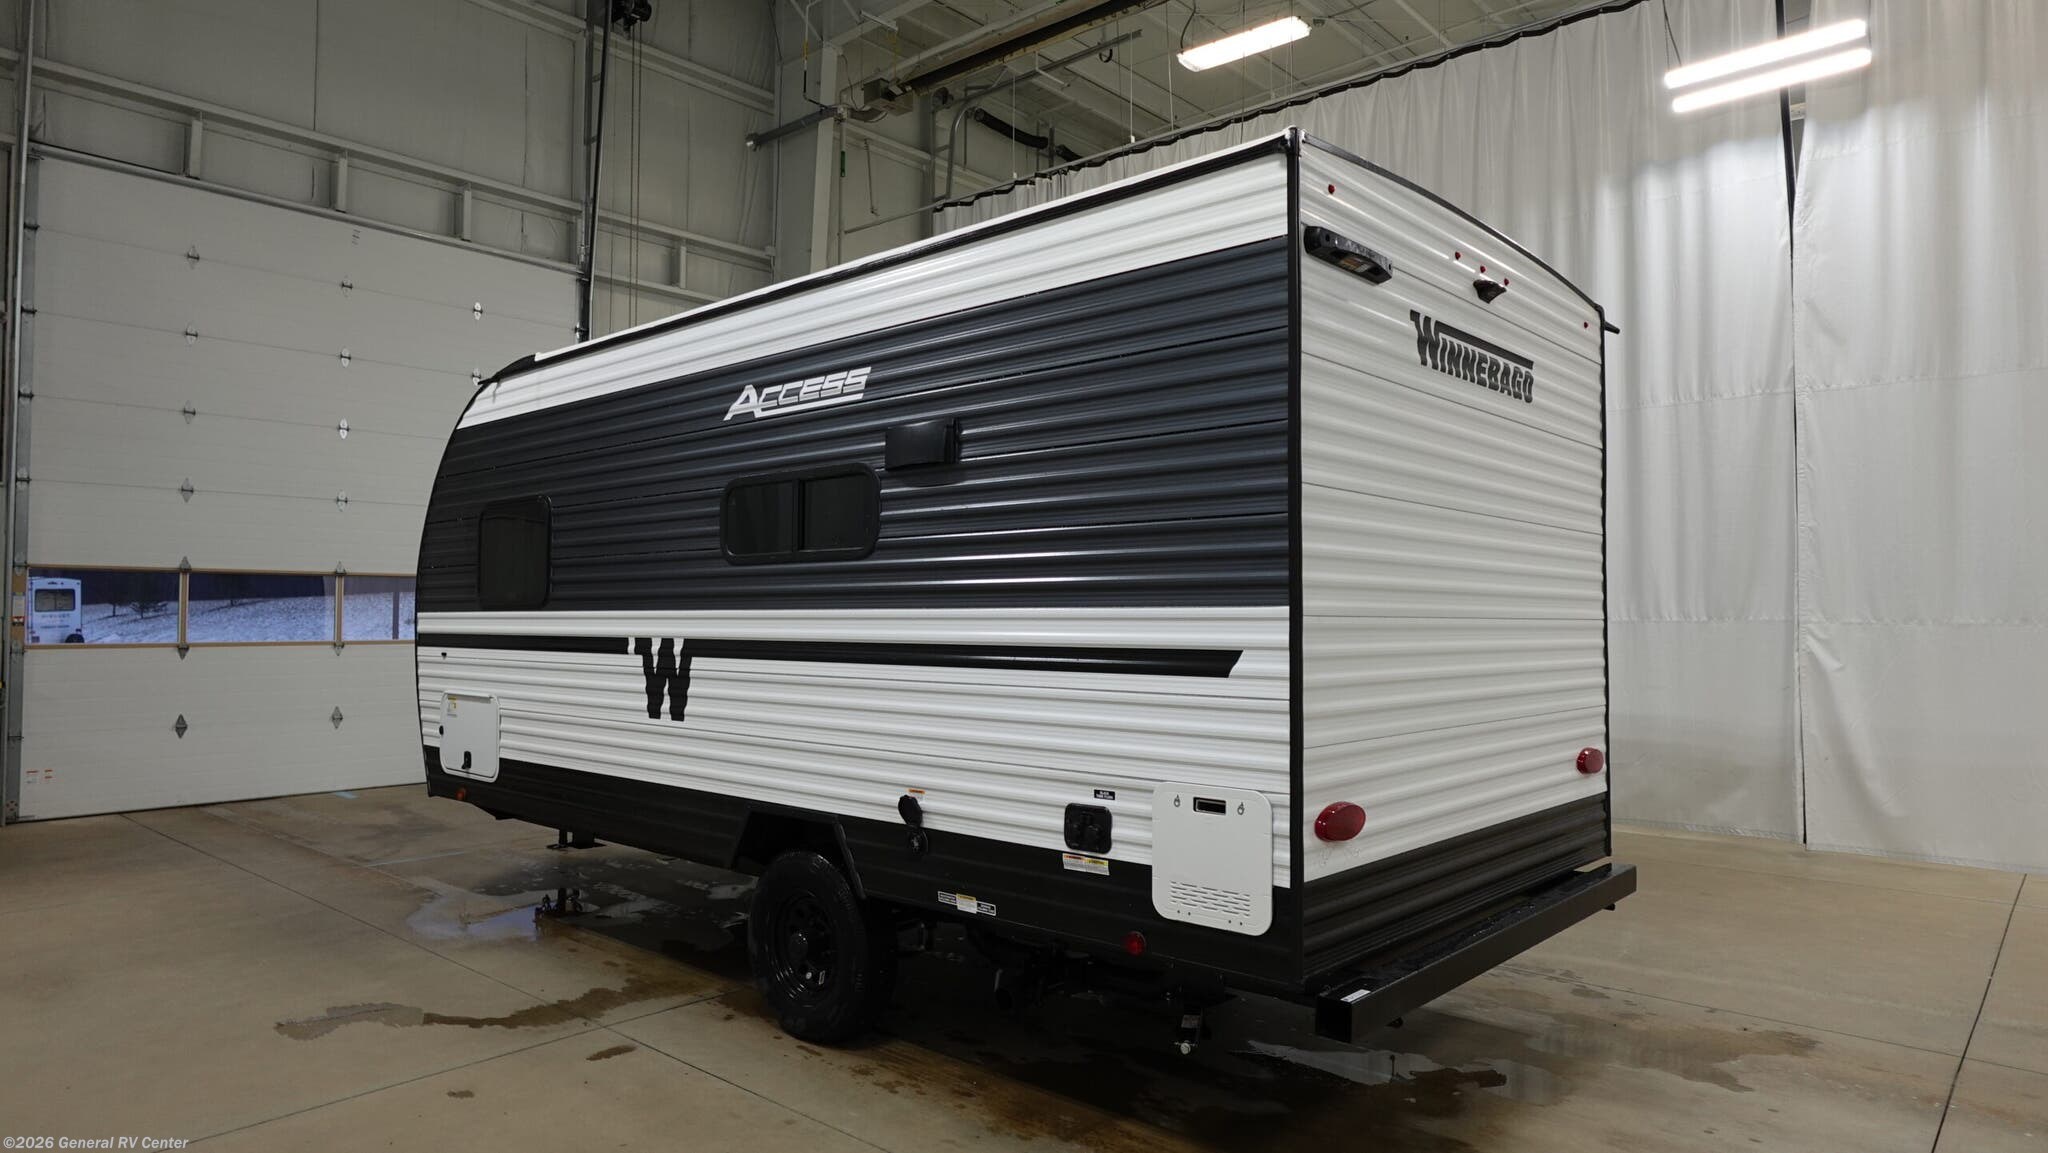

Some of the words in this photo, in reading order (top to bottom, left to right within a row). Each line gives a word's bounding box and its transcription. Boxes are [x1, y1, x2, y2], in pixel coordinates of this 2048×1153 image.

[723, 366, 872, 421] ACCESS
[1410, 309, 1534, 403] WINNEBAGO
[633, 636, 695, 722] W
